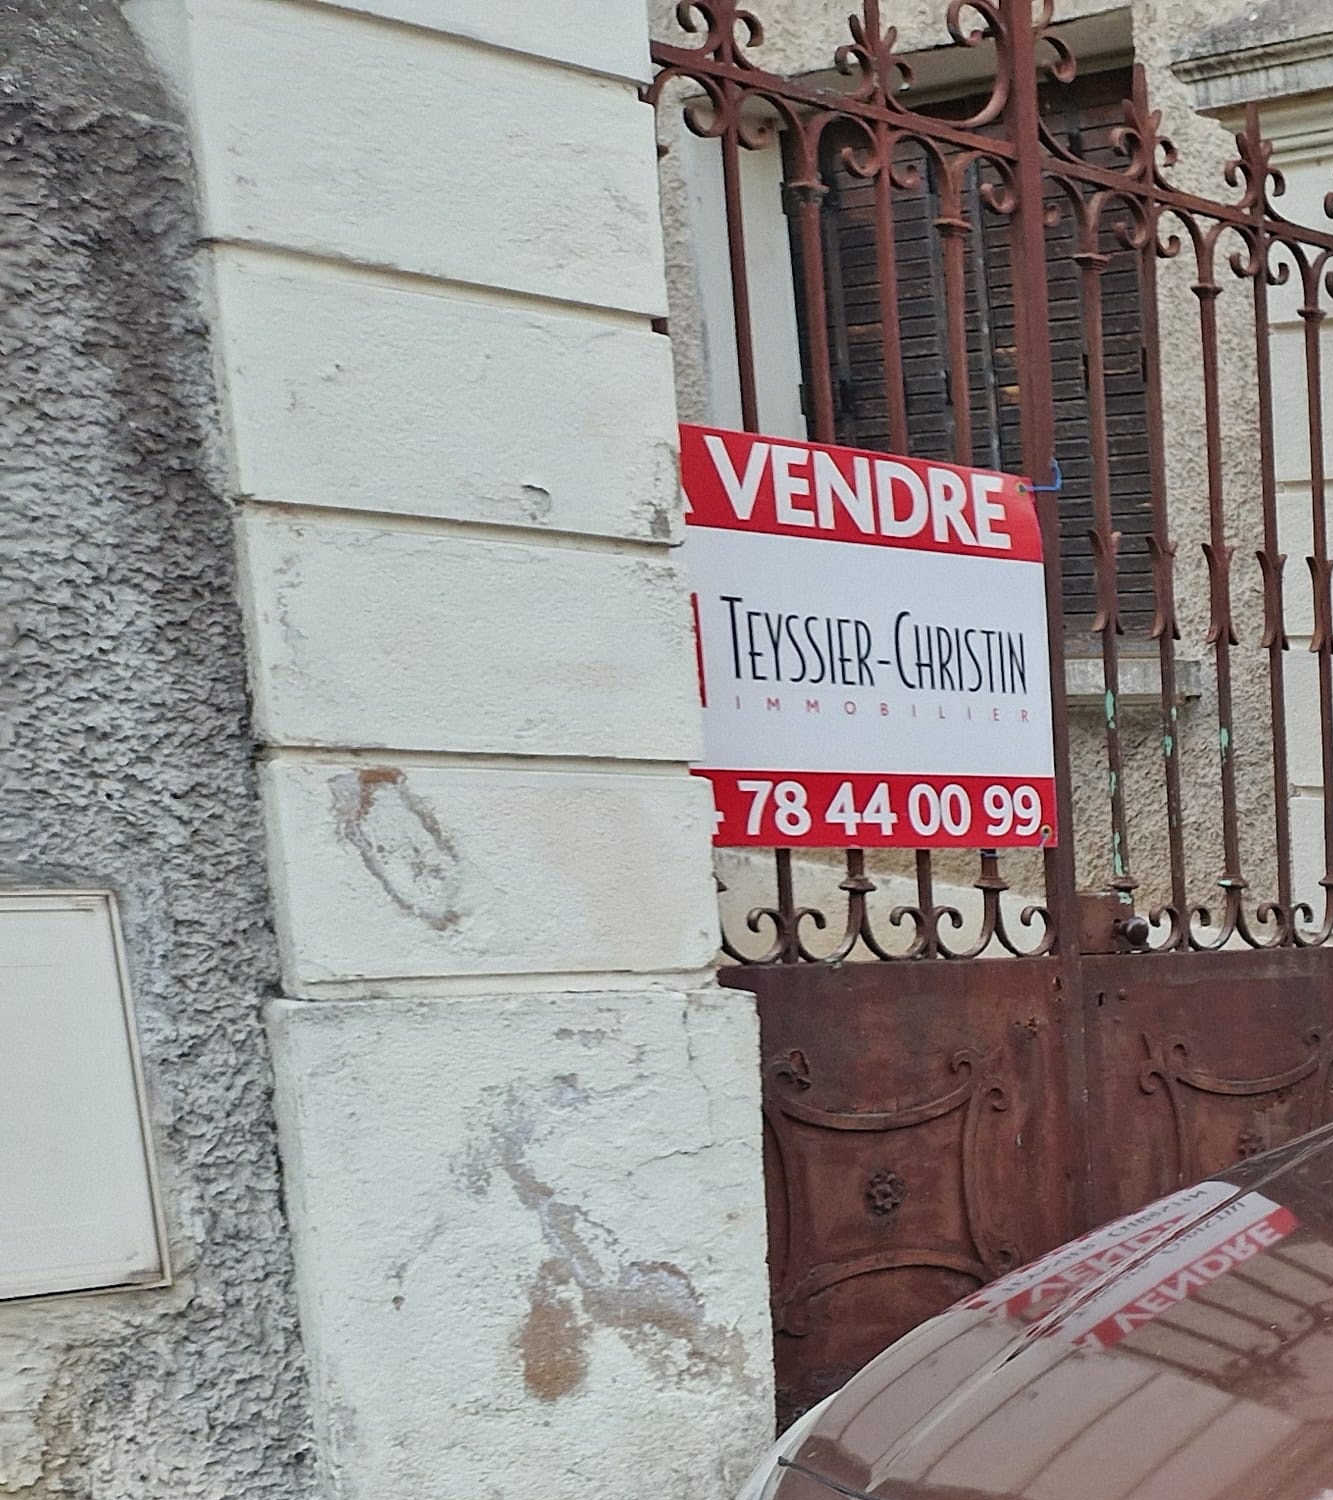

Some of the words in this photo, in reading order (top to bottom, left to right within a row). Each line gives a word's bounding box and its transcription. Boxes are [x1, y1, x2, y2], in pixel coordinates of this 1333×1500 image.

[704, 435, 1011, 550] VENDRE
[736, 696, 1029, 723] IMMOBILIER
[737, 780, 812, 836] 78
[824, 781, 898, 836] 44
[908, 783, 972, 837] 00
[983, 785, 1042, 837] 99
